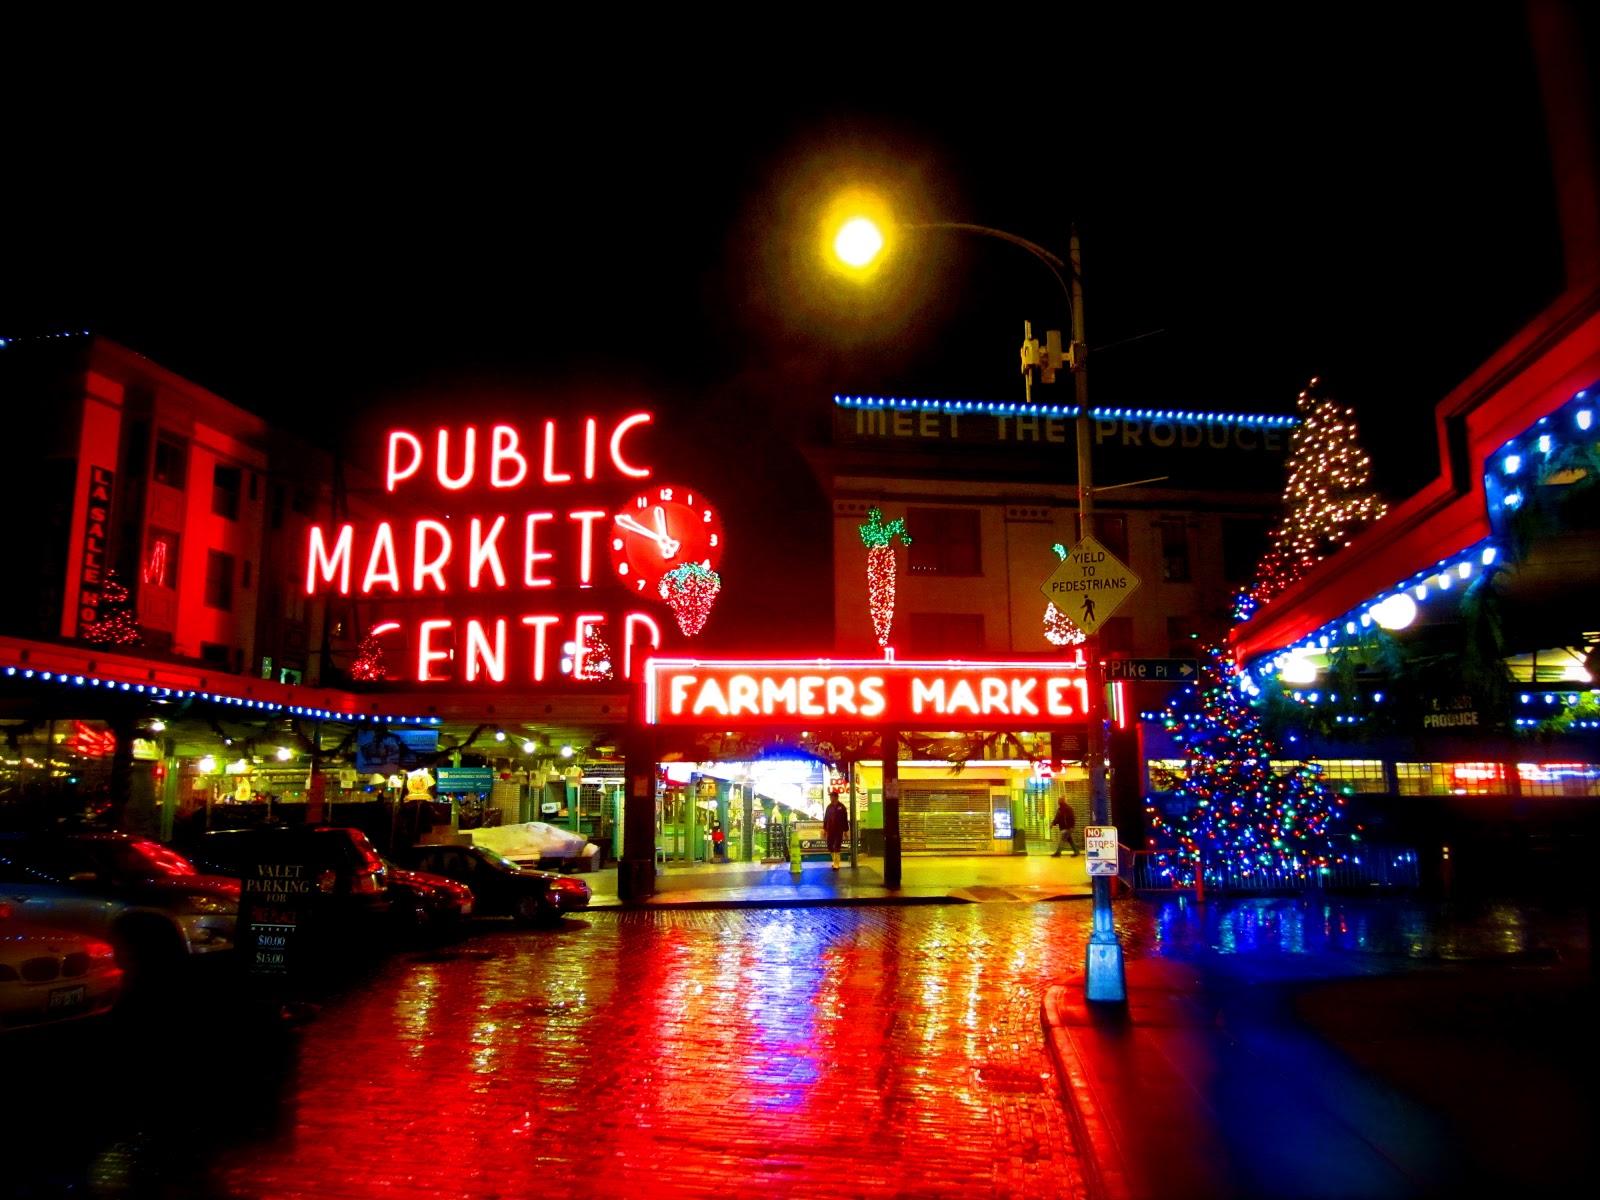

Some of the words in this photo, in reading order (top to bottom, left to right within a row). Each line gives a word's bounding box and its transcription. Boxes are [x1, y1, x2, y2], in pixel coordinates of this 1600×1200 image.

[857, 407, 963, 438] MEET
[993, 415, 1066, 442] THE
[385, 412, 652, 493] PUBLIC
[660, 488, 673, 501] 12
[687, 494, 693, 506] 1
[637, 496, 648, 508] 11
[703, 510, 712, 522] 2
[84, 507, 106, 584] SALLE
[613, 538, 623, 551] 9
[709, 533, 718, 546] 3
[306, 511, 606, 595] MARKET
[1072, 551, 1105, 564] YIELD
[618, 562, 629, 575] 8
[1082, 566, 1096, 577] TO
[636, 579, 646, 591] 7
[1052, 577, 1127, 592] PEDESTRIANS
[1111, 661, 1147, 677] Pike
[670, 675, 886, 717] FARMERS
[1087, 828, 1100, 837] NO
[1088, 840, 1115, 849] STOPS
[257, 864, 303, 878] VALET
[245, 879, 310, 893] PARKING
[266, 893, 287, 902] FOR
[258, 935, 286, 946] $10.00
[256, 952, 284, 963] $15.00
